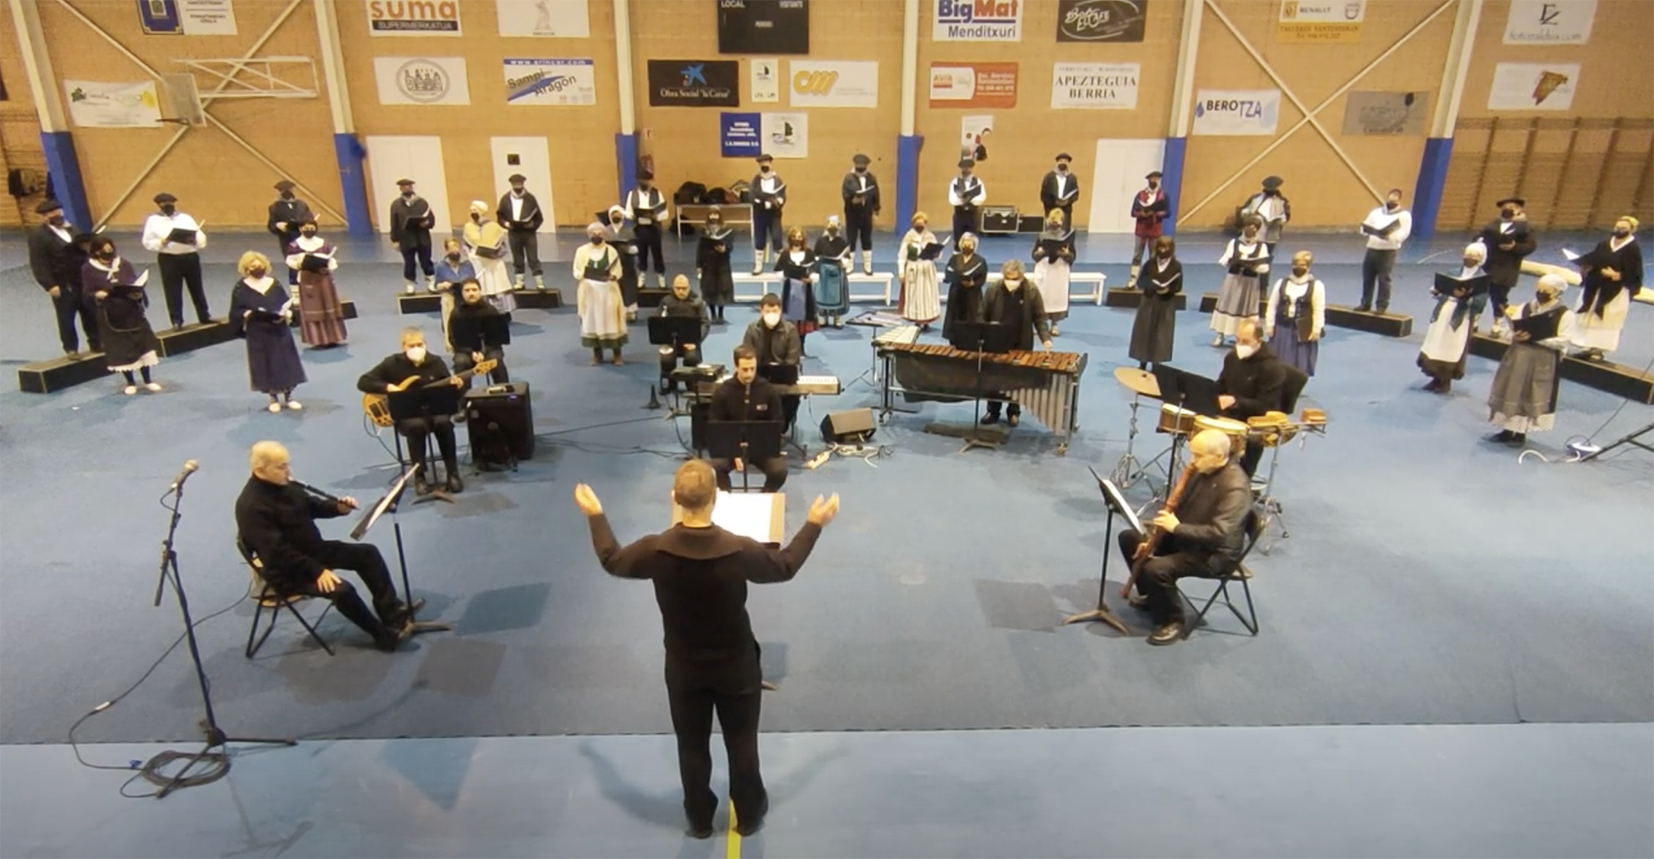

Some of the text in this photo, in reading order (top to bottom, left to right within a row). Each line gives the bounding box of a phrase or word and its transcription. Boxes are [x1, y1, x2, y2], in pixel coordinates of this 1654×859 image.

[371, 0, 457, 19] suma
[938, 0, 1018, 23] BigMat
[378, 21, 453, 30] SUPERMERKATUA
[948, 25, 1016, 38] Menditxuri
[1055, 75, 1137, 87] APEZTEGUIA
[660, 88, 678, 98] Obra
[679, 88, 699, 98] Social
[1069, 88, 1116, 99] BERRIA
[1206, 99, 1262, 118] BEROTZA
